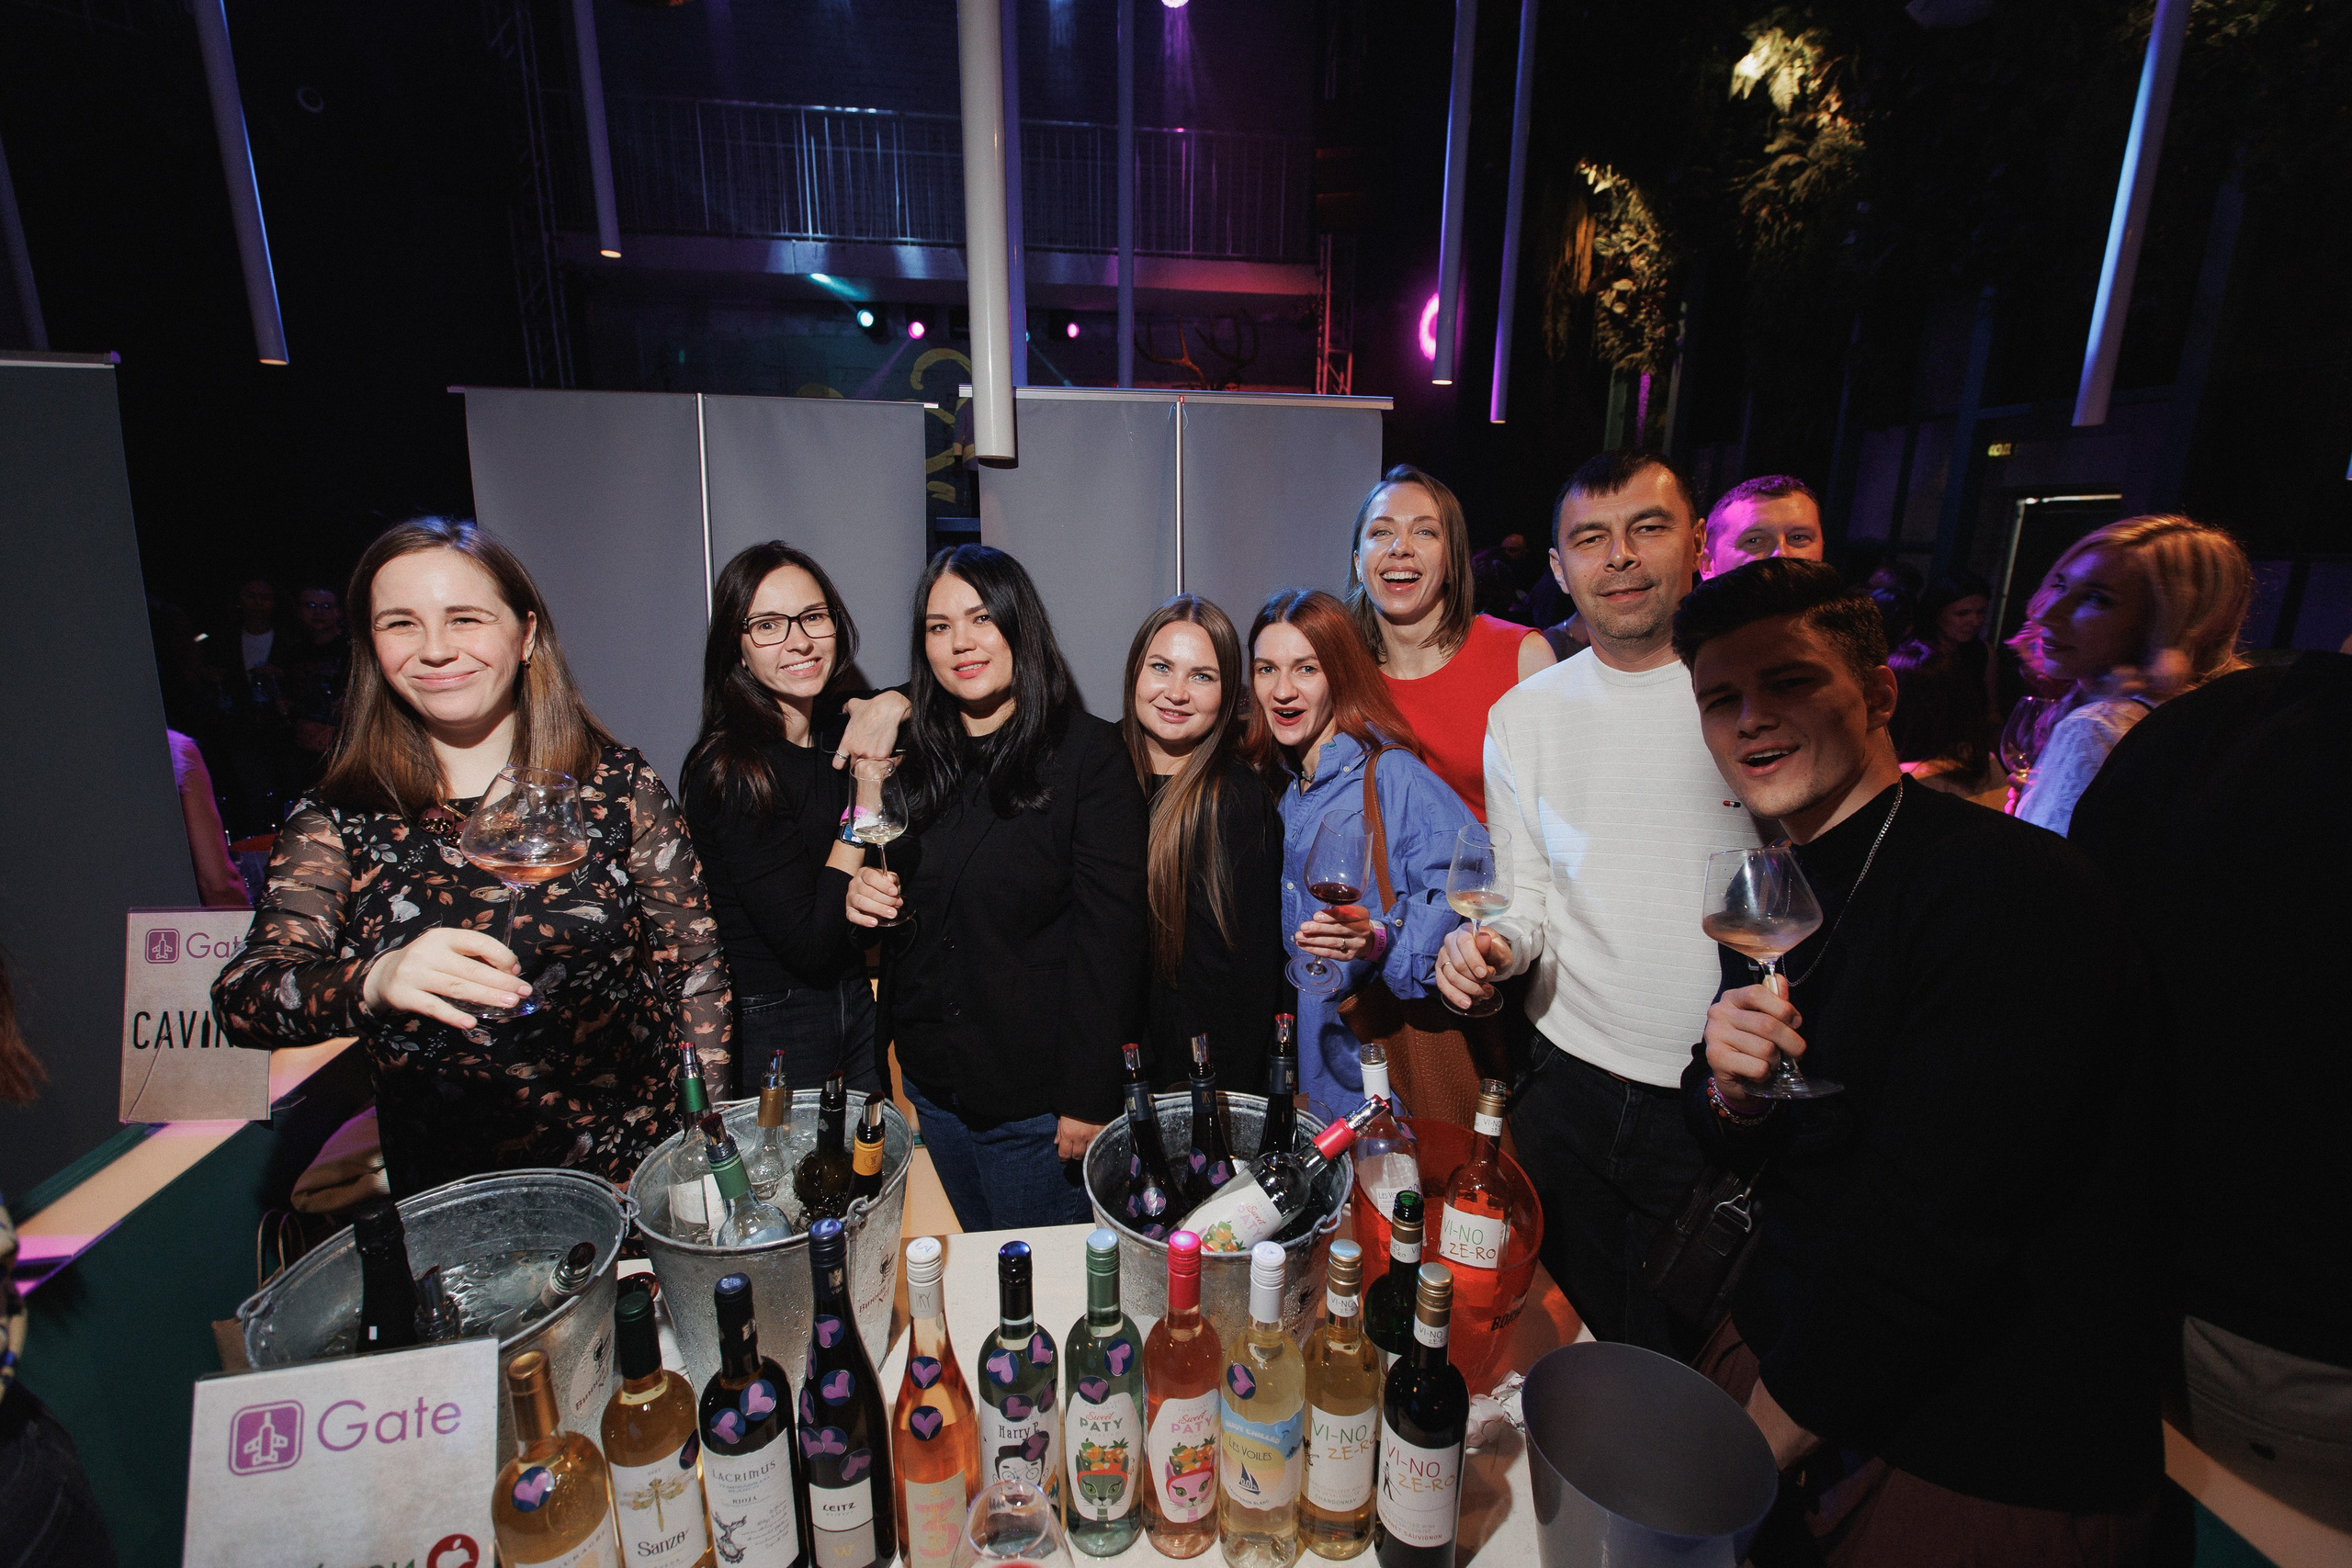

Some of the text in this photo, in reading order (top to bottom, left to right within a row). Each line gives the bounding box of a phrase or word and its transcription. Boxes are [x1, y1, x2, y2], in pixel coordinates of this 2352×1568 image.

[186, 931, 243, 959] Gat
[1443, 1219, 1484, 1246] VI-NO
[1449, 1242, 1497, 1260] ZE-RO
[1419, 1325, 1442, 1338] VI-NO
[317, 1396, 462, 1451] Gate
[1080, 1417, 1123, 1432] PATY
[1086, 1412, 1114, 1420] Sweet
[1171, 1415, 1213, 1433] PATY
[1179, 1410, 1207, 1424] Sweet
[999, 1425, 1031, 1440] Harry
[1311, 1417, 1367, 1444] VI-NO
[1228, 1436, 1272, 1461] LES VOILES
[1328, 1430, 1376, 1461] ZE-RO
[1386, 1437, 1441, 1478] VI-NO
[1397, 1473, 1455, 1493] ZE-RO
[1315, 1494, 1357, 1505] CHARDONNAY
[1404, 1530, 1442, 1540] SAUVIGNON
